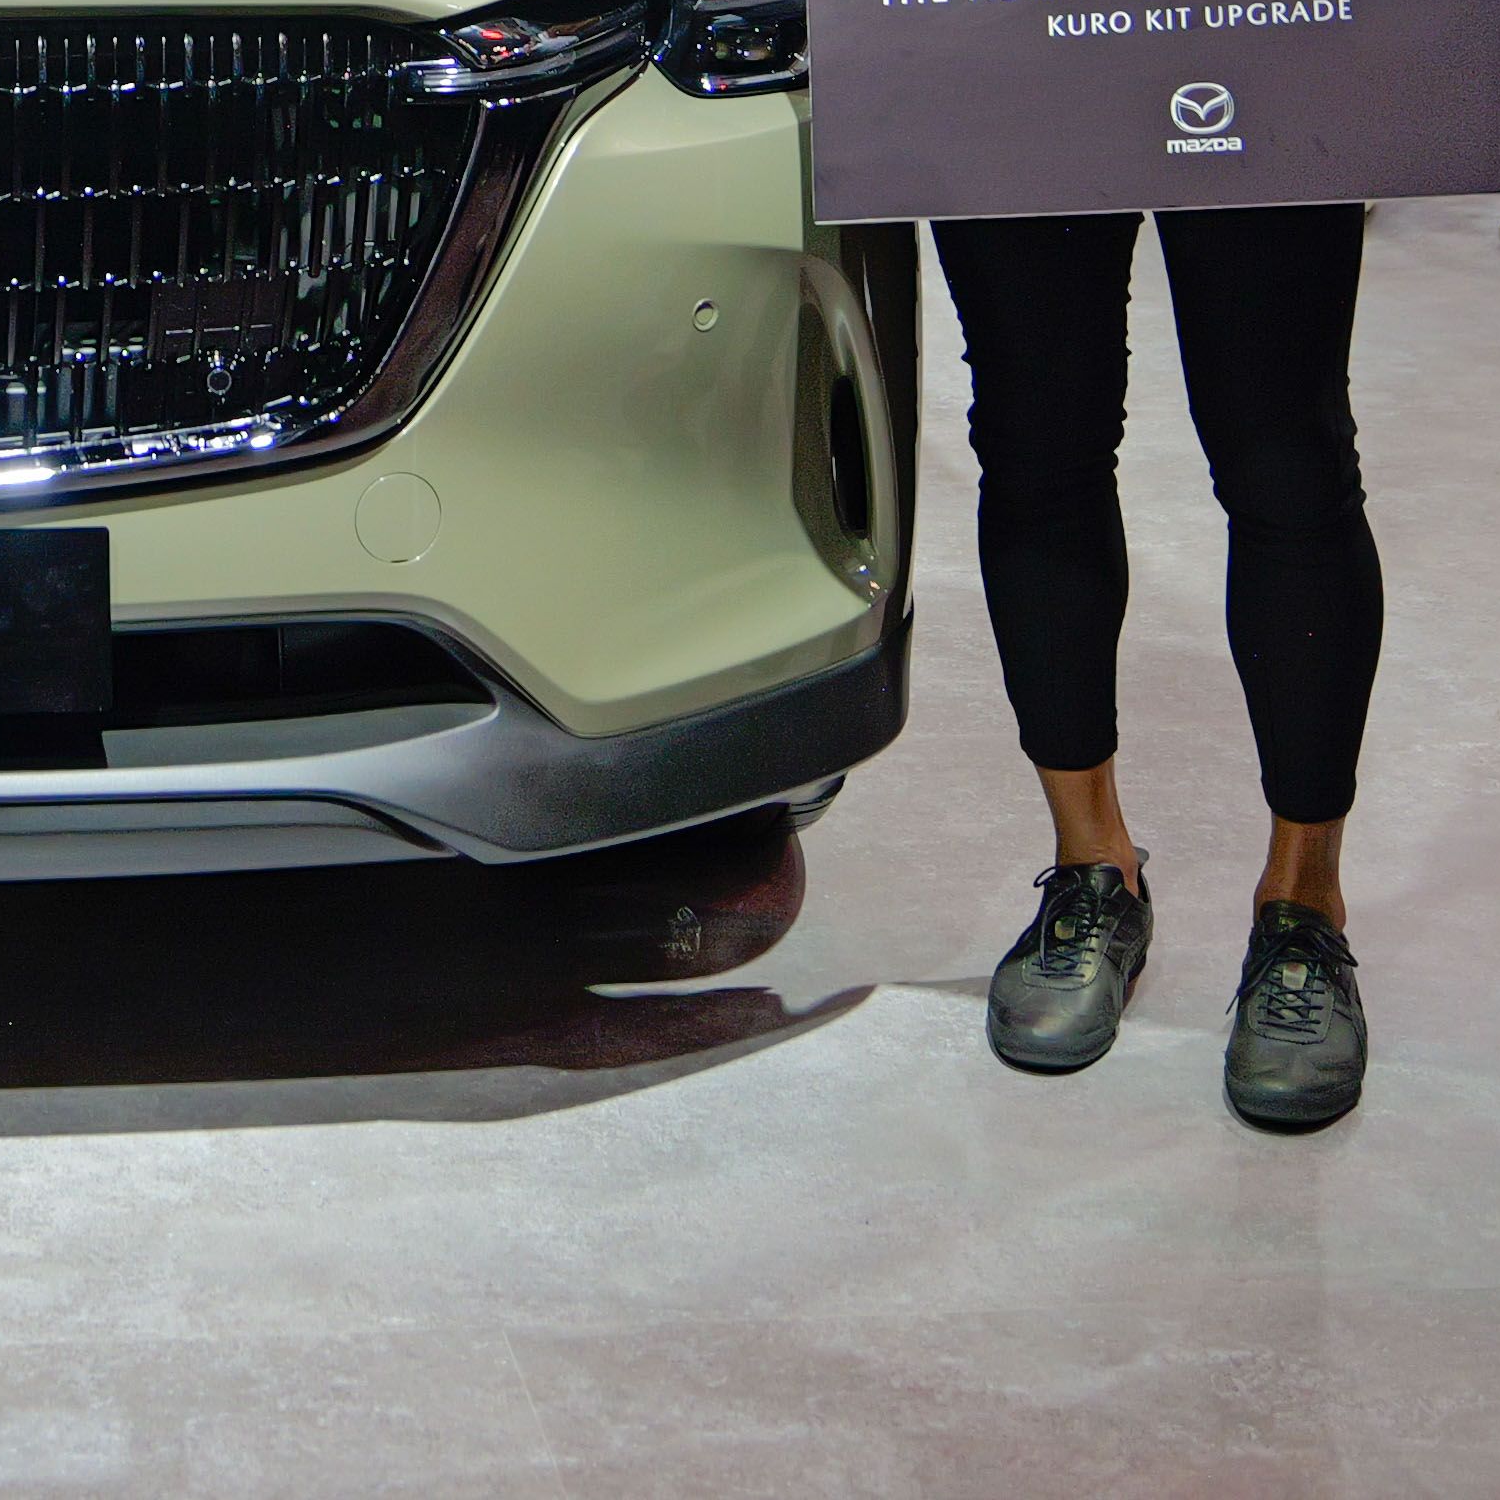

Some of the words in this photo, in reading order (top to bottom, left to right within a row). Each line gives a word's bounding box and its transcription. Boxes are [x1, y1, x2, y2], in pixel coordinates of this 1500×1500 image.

[1047, 10, 1132, 37] KURO
[1145, 7, 1191, 32] KIT
[1166, 136, 1243, 154] mazda
